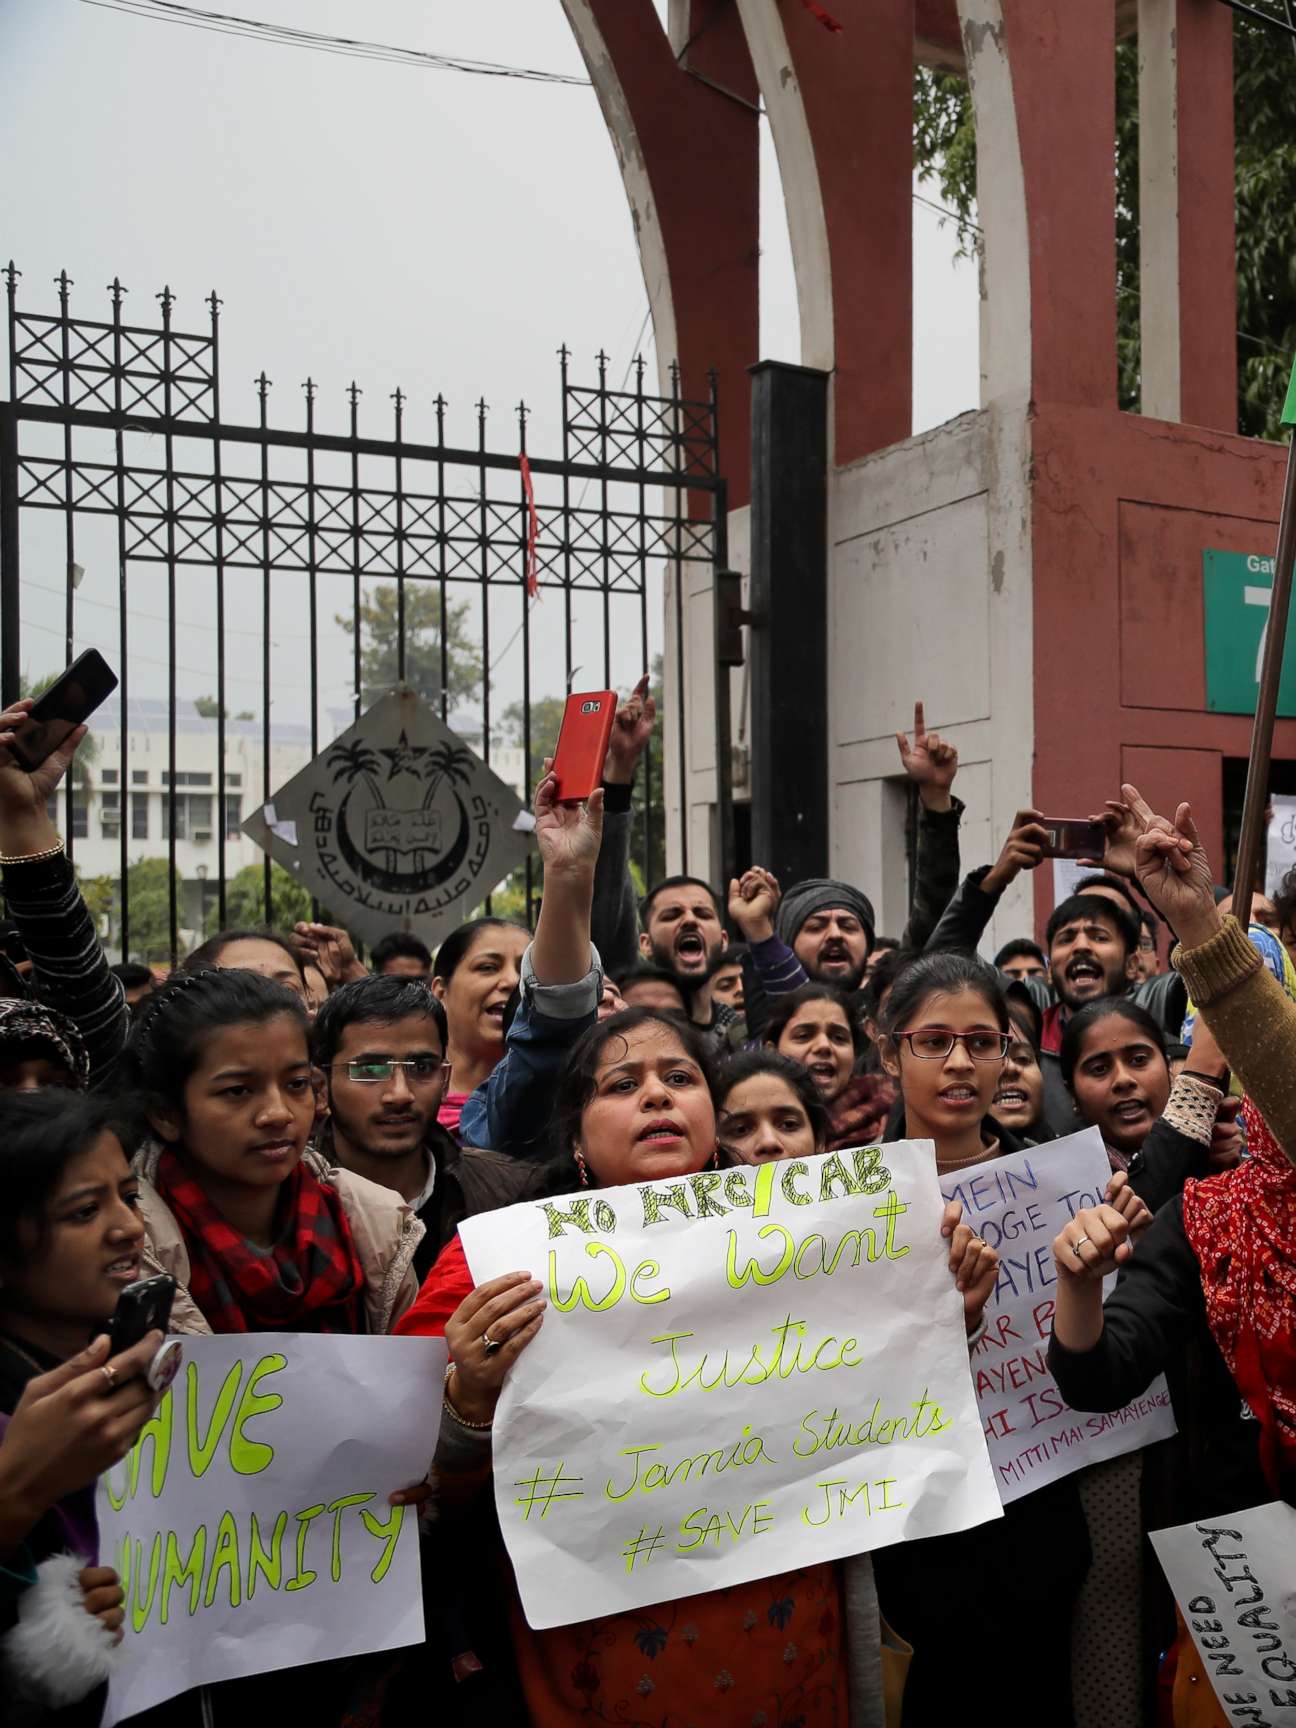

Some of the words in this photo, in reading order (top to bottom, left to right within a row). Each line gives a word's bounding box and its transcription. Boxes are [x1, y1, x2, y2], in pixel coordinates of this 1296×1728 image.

[1246, 554, 1277, 575] Gat
[548, 1241, 672, 1314] We
[724, 1189, 912, 1290] Want
[969, 1203, 1048, 1251] OGE
[639, 1313, 863, 1398] Justice
[976, 1349, 1047, 1400] AYEN
[1018, 1387, 1072, 1429] IS
[605, 1424, 778, 1501] Jamia
[792, 1387, 956, 1459] Students
[802, 1477, 903, 1528] JMI
